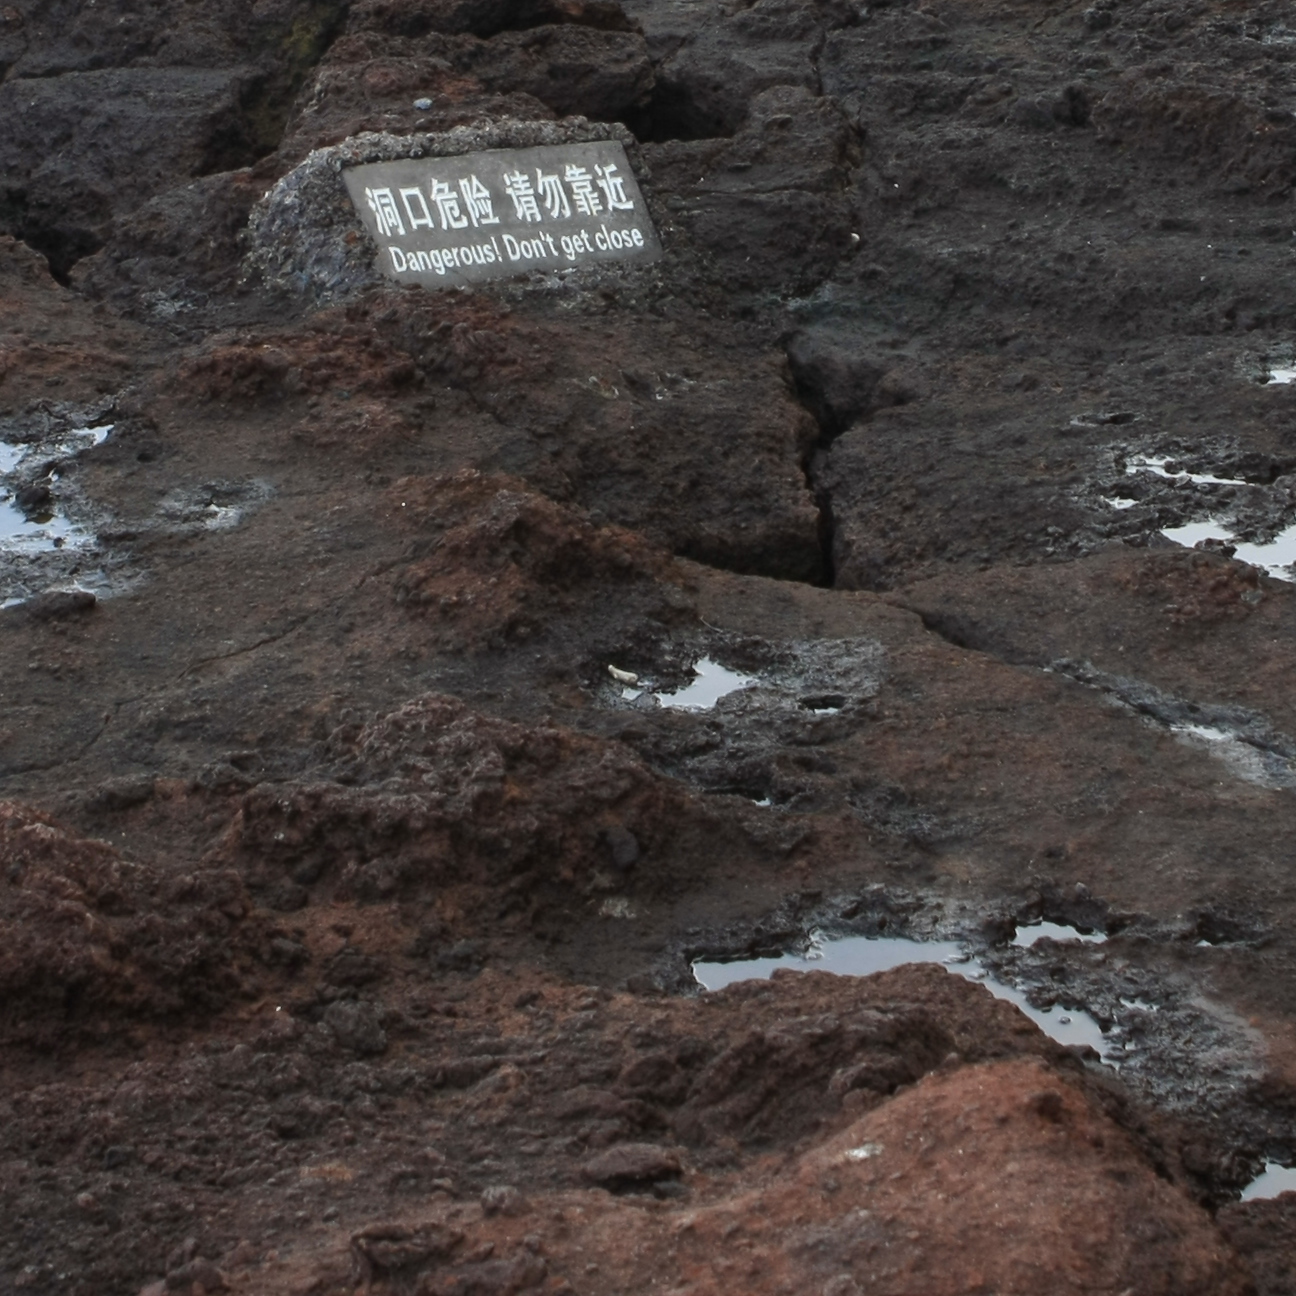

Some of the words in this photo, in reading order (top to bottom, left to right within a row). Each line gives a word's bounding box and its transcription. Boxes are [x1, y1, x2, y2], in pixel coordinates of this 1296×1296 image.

[365, 174, 500, 236] 洞口危险
[503, 163, 634, 222] 请勿靠近
[388, 236, 504, 275] Dangerous!
[503, 232, 559, 261] Don't
[561, 231, 594, 261] get
[595, 225, 644, 251] close
